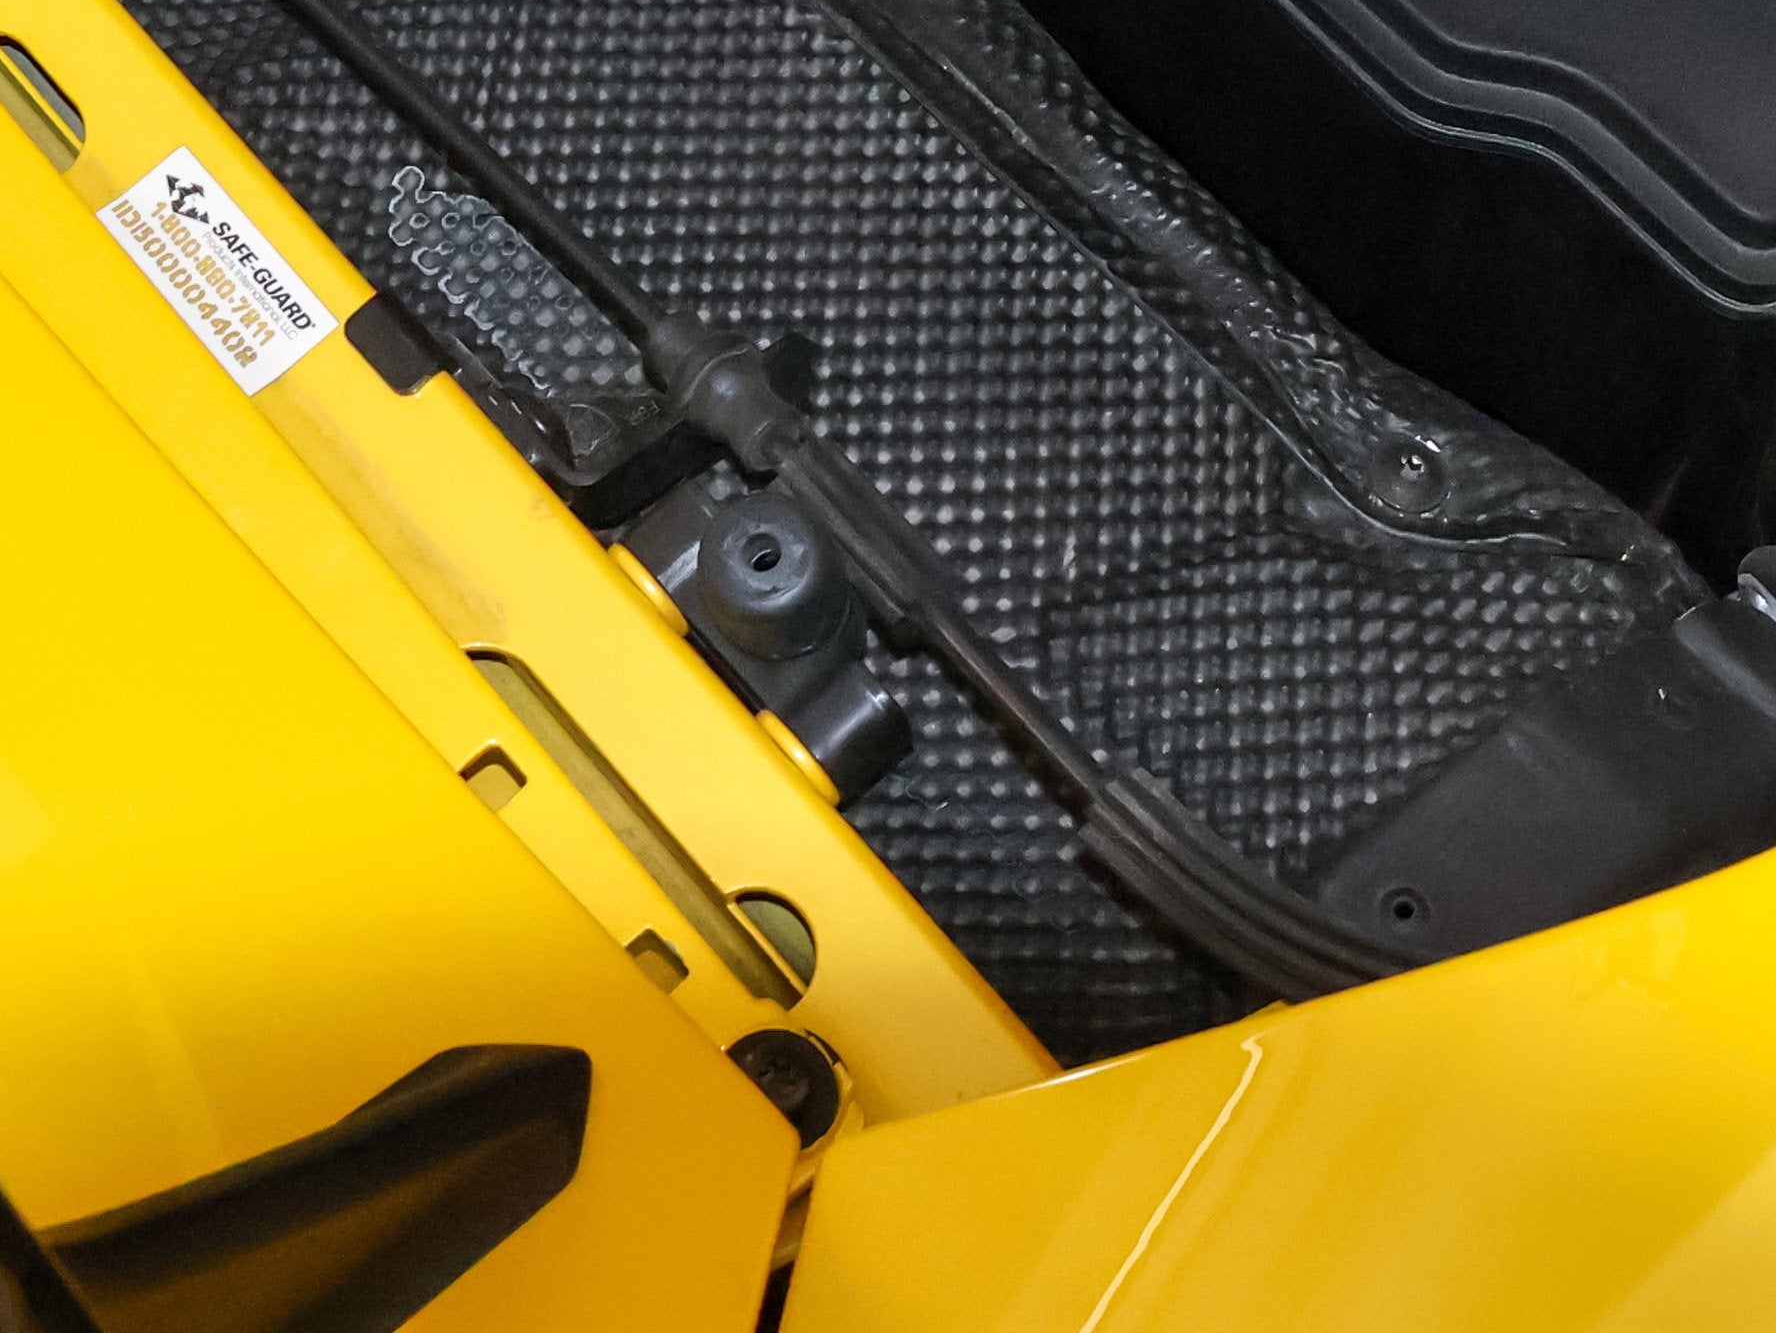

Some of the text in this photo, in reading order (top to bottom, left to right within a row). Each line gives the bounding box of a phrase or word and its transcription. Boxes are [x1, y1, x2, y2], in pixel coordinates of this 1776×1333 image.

[202, 232, 237, 270] Products
[278, 321, 298, 341] LLC
[212, 221, 312, 331] SAFE-GUARD
